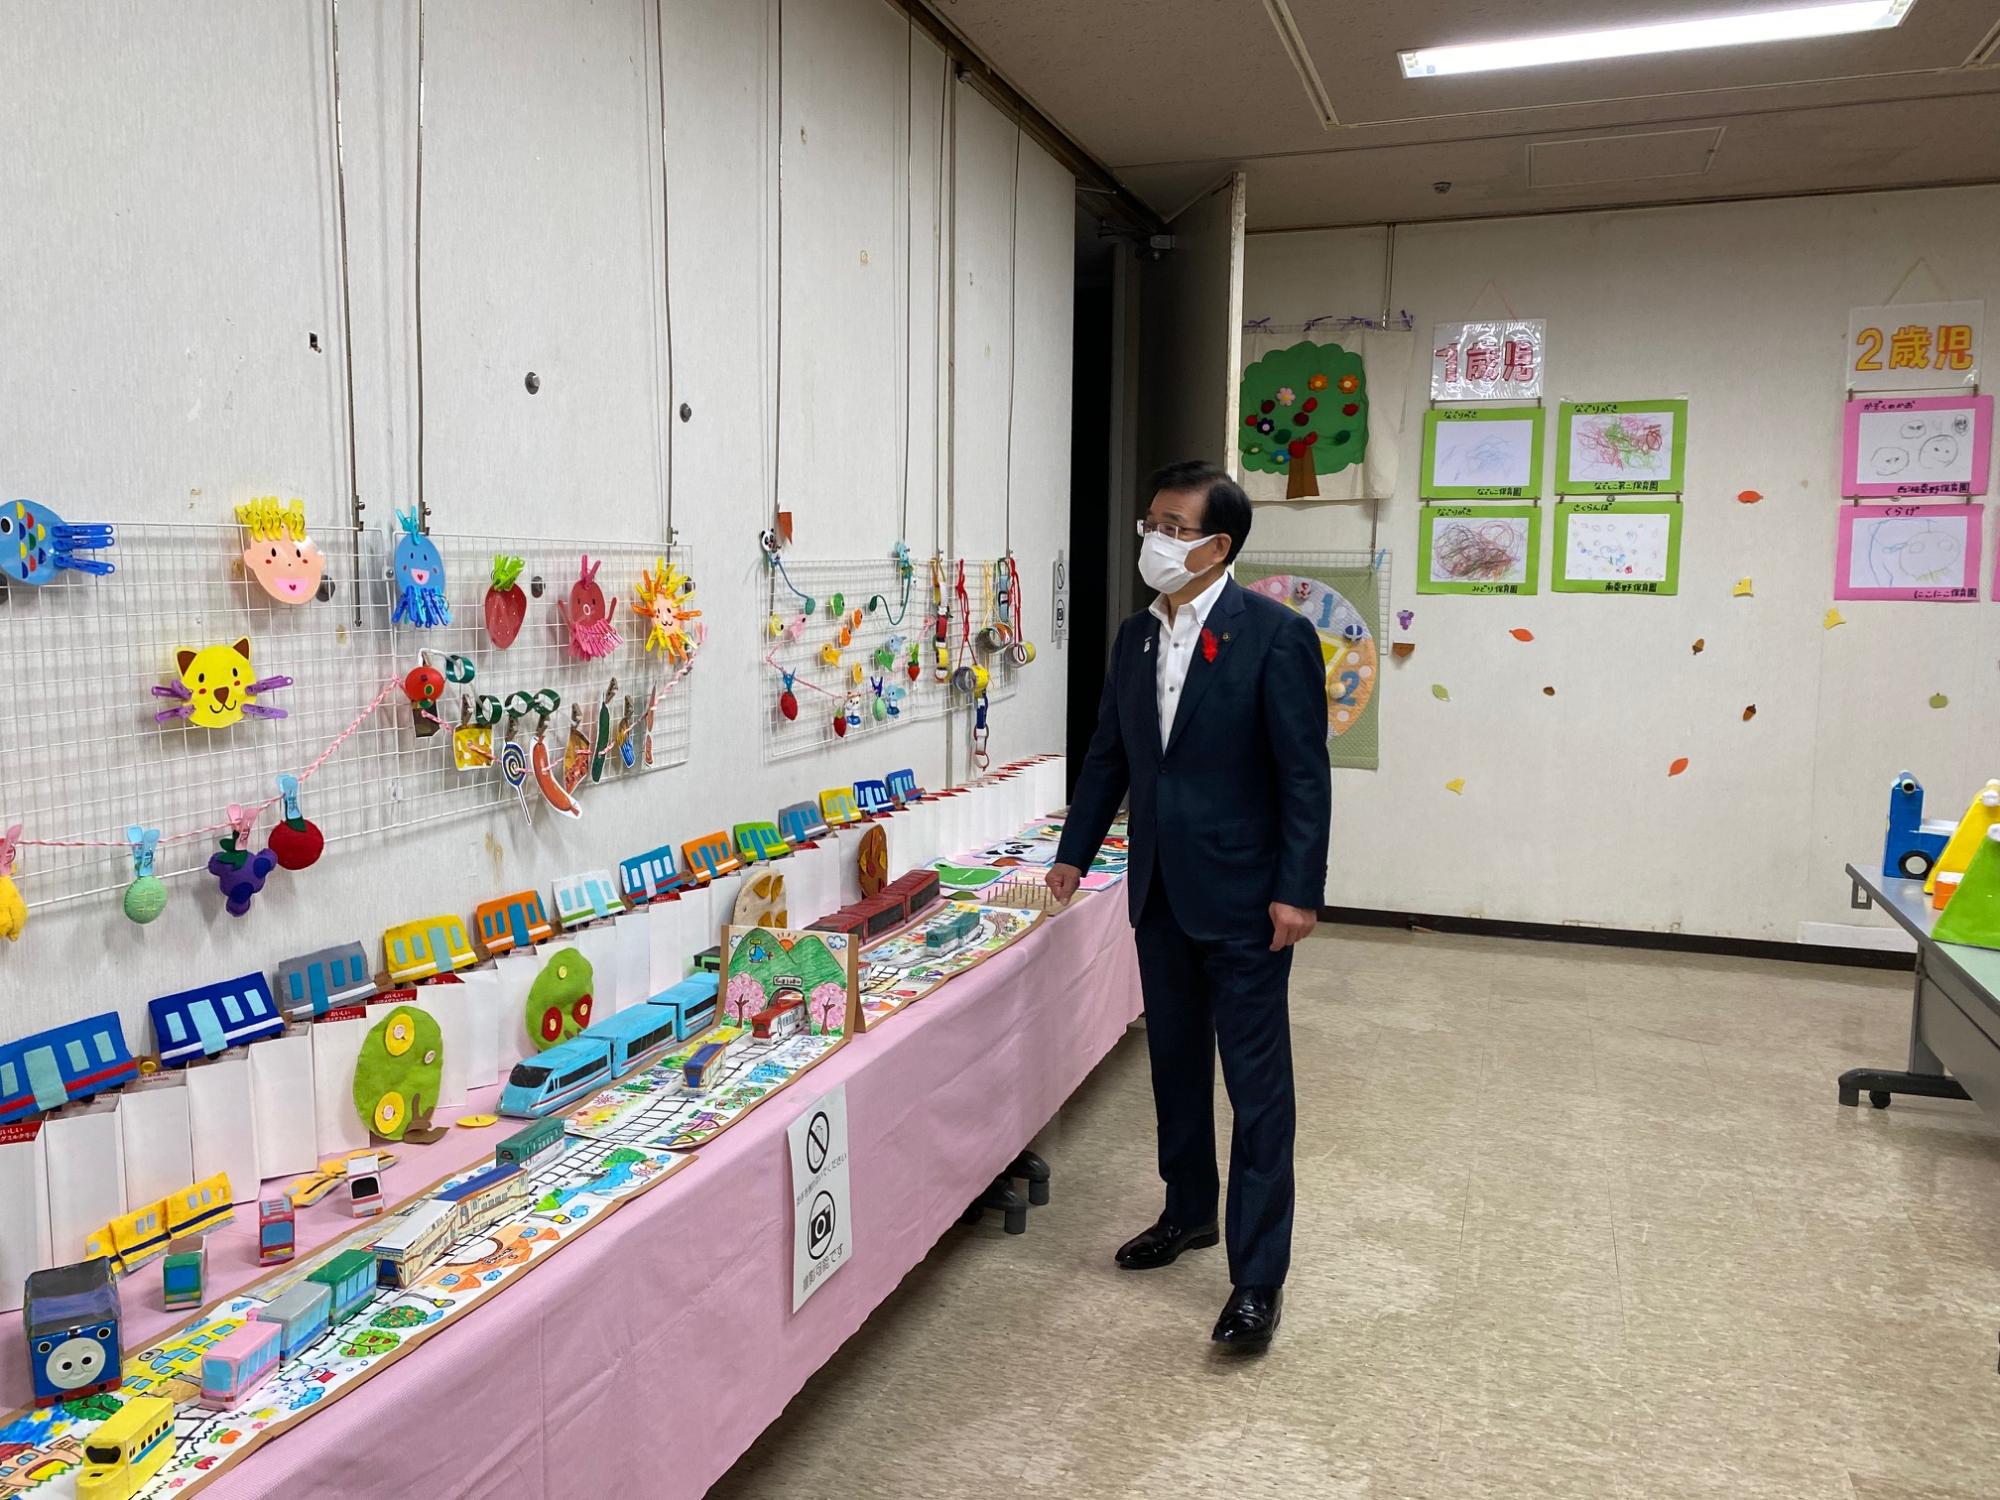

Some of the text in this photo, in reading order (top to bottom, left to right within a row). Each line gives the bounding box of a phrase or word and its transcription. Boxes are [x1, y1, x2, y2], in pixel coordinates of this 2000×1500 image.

[1855, 324, 1974, 371] 2歳児
[1435, 340, 1534, 383] 1歳児
[1573, 404, 1617, 415] なぐりがき
[1863, 399, 1916, 411] かぞくのかお
[1476, 487, 1522, 496] なでしこ保育園
[1437, 507, 1473, 517] なぐりがき
[1573, 502, 1613, 512] さくらんぼ
[1885, 506, 1921, 516] くらげ
[1471, 583, 1518, 594] みどり保育園
[1913, 587, 1977, 599] にこにこ保育園
